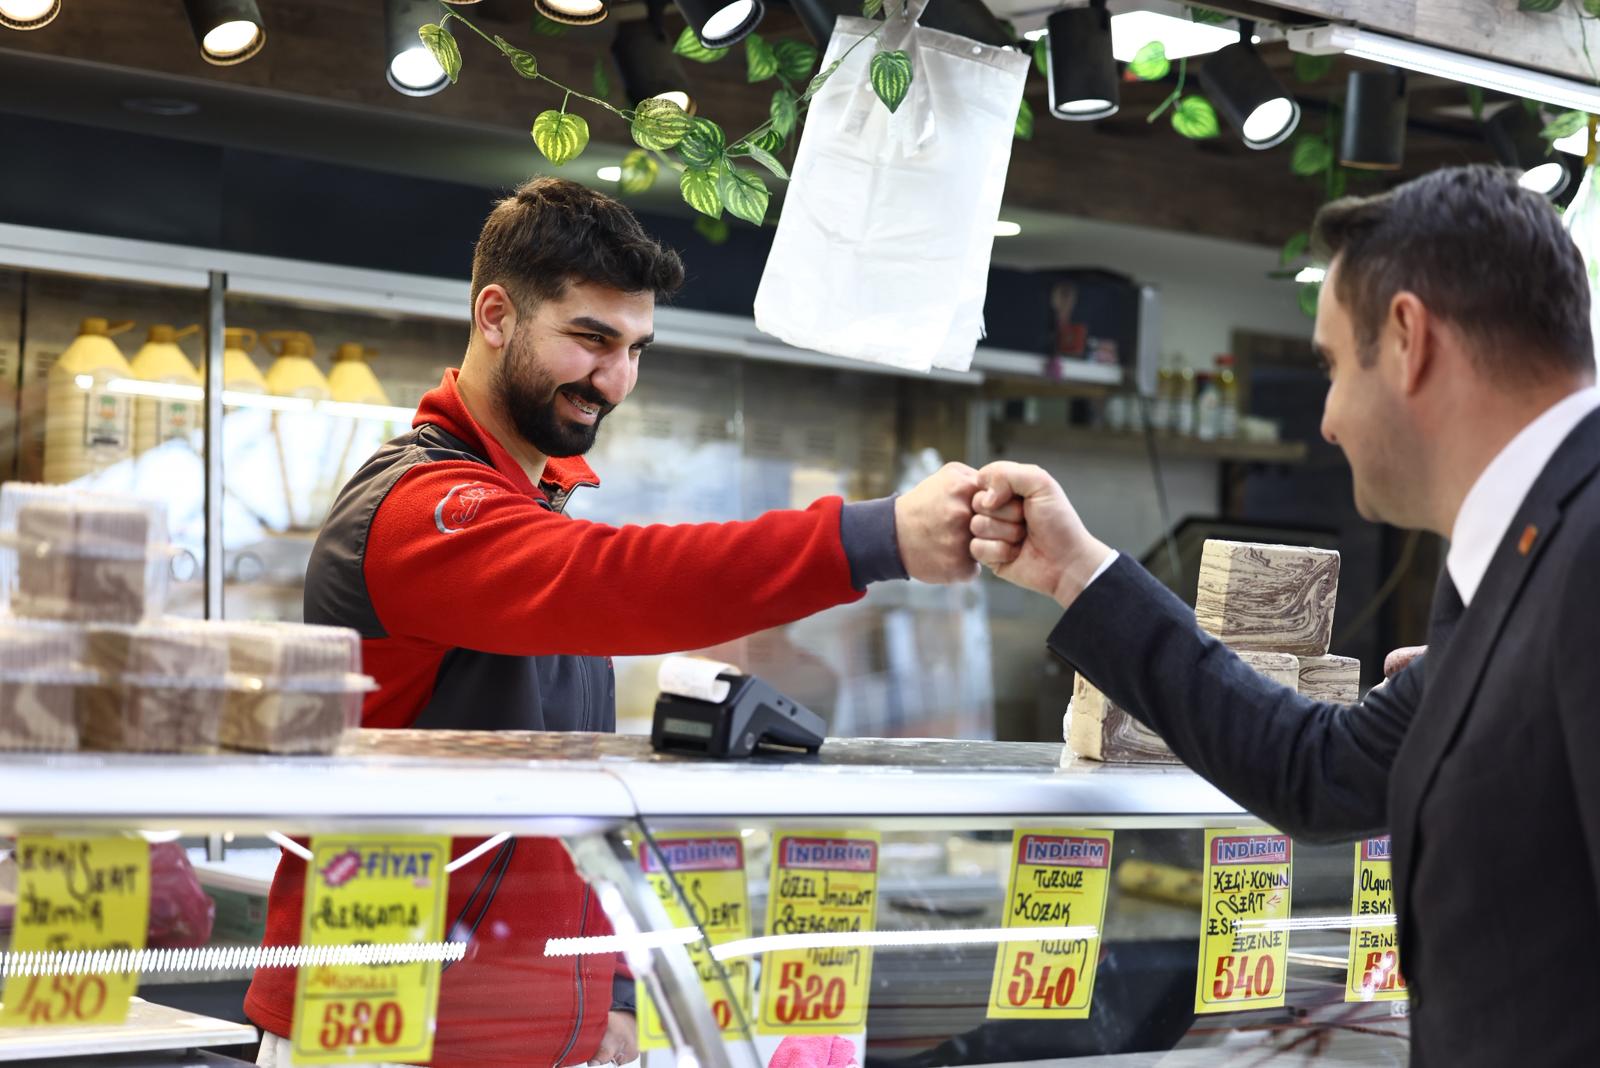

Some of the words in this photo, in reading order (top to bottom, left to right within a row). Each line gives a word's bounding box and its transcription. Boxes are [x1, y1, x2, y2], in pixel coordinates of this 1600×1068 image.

[788, 839, 871, 864] İNDİRİM
[1027, 838, 1103, 860] İNDİRİM
[1218, 839, 1285, 860] İNDİRİM
[775, 961, 846, 1024] 520
[1008, 951, 1076, 1009] 540
[1213, 953, 1275, 1000] 540
